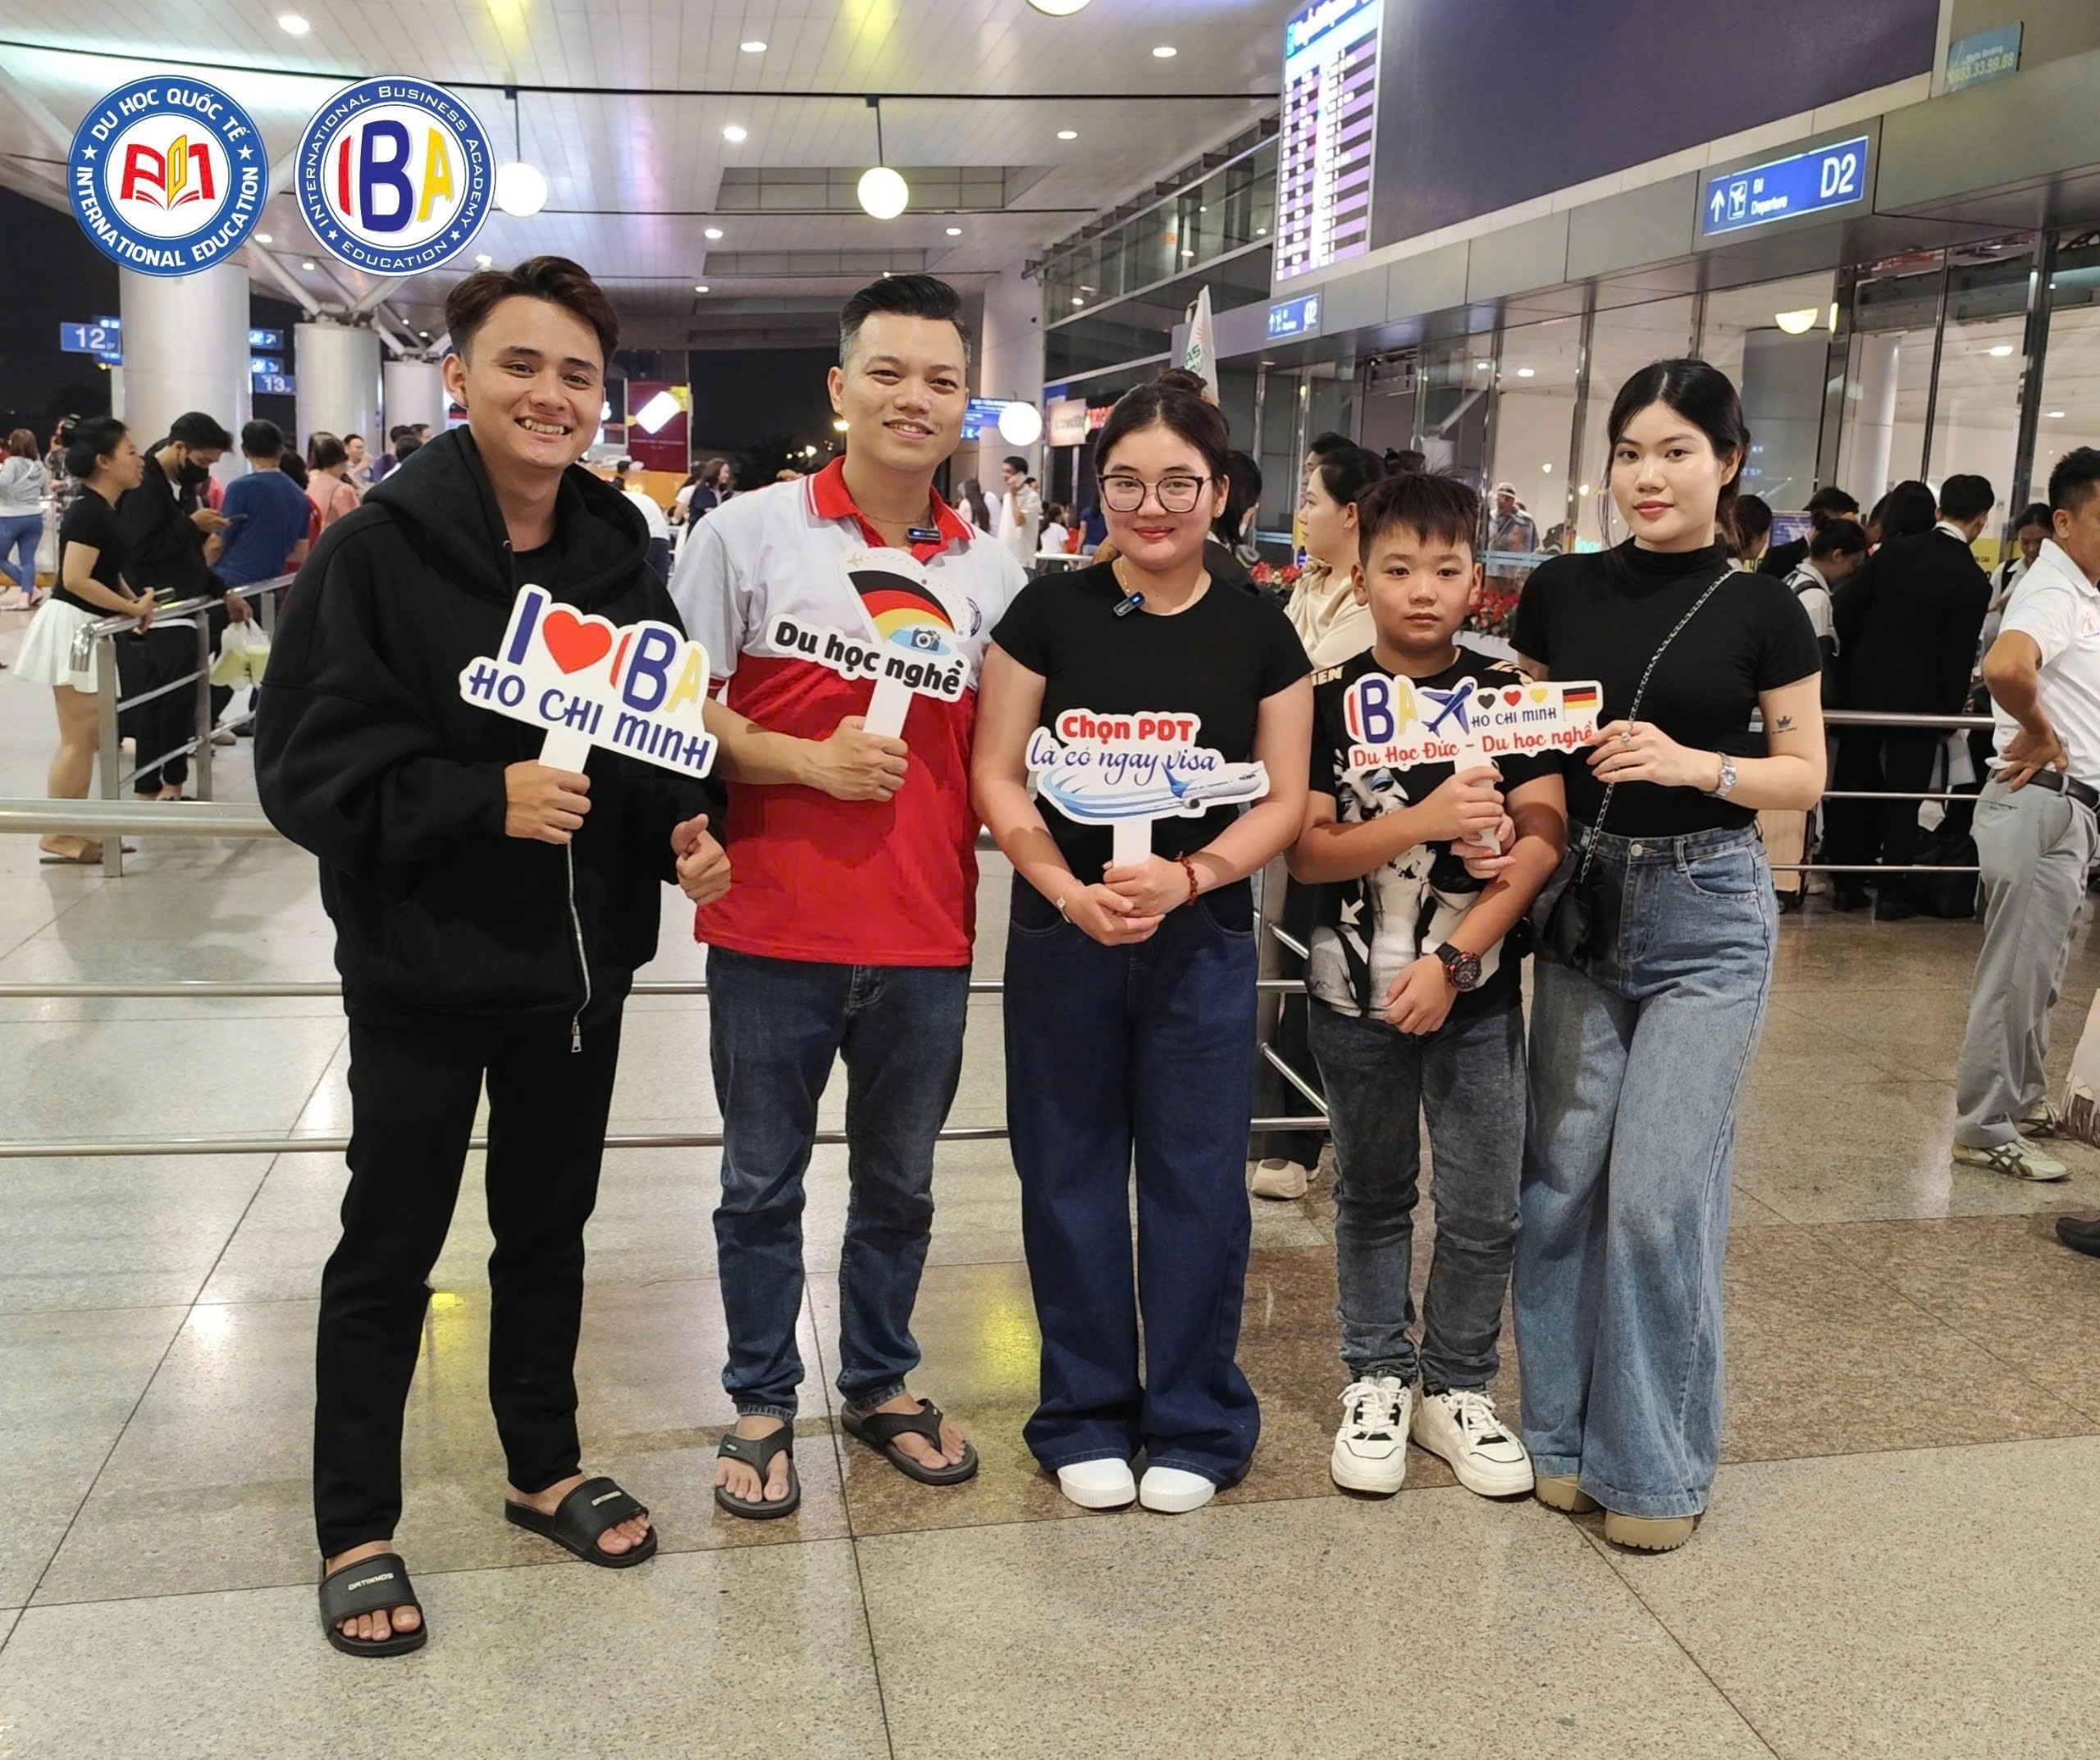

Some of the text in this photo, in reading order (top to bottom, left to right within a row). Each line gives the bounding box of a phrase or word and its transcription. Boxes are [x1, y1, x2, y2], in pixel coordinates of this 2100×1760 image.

[1820, 153, 1856, 198] D2
[75, 326, 106, 349] 12
[262, 375, 285, 393] 13
[507, 592, 703, 713] I IBA
[775, 621, 964, 695] Du học nghề
[468, 664, 710, 770] HO CHI MINH
[1062, 715, 1193, 745] Chọn PDT
[1349, 679, 1418, 744] IBA
[1471, 707, 1557, 727] HO CHI MINH
[1030, 734, 1217, 786] là có ngay visa
[1354, 749, 1381, 767] Du
[1385, 745, 1419, 767] Học
[1422, 740, 1460, 759] Đức
[1482, 735, 1509, 752] Du
[1513, 732, 1546, 752] học
[1551, 720, 1593, 749] nghề
